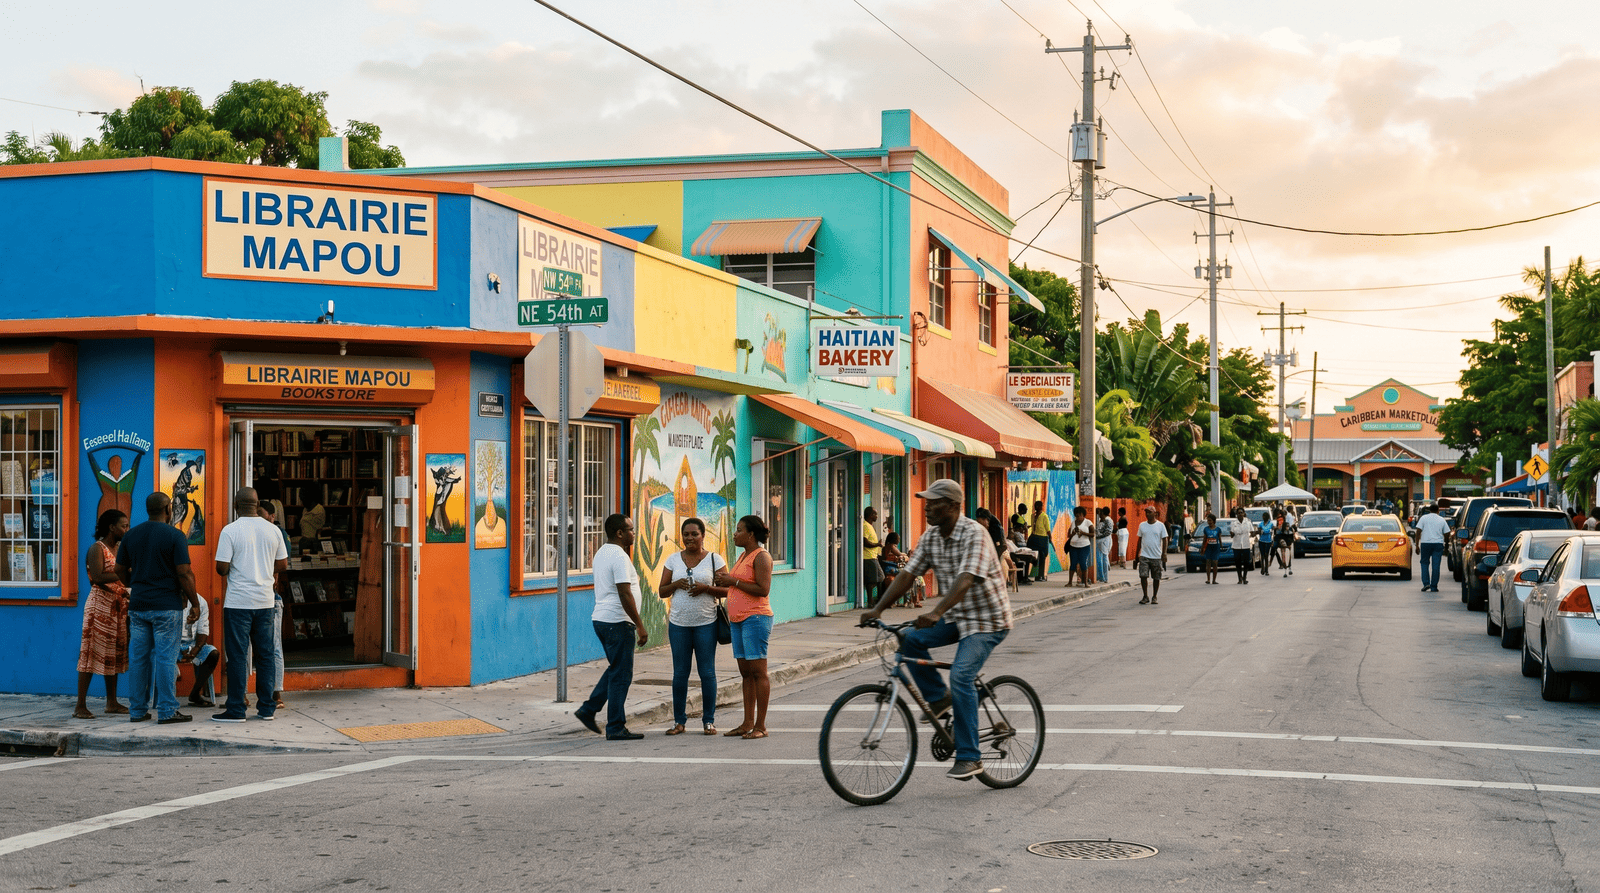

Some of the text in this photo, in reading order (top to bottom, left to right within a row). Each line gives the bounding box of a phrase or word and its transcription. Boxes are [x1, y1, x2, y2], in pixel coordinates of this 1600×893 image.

[215, 189, 428, 236] LIBRAIRIE
[243, 235, 400, 277] MAPOU
[523, 226, 599, 277] LIBRAIRIE
[543, 269, 557, 290] NW
[520, 303, 604, 323] NE 54th AT
[818, 329, 895, 347] HAITIAN
[818, 349, 894, 366] BAKERY
[246, 366, 411, 387] LIBRAIRIE MAPOU
[1008, 376, 1071, 387] LE SPECIALISTE
[281, 387, 376, 400] BOOKSTORE
[1340, 409, 1386, 428] CARIBBEAN
